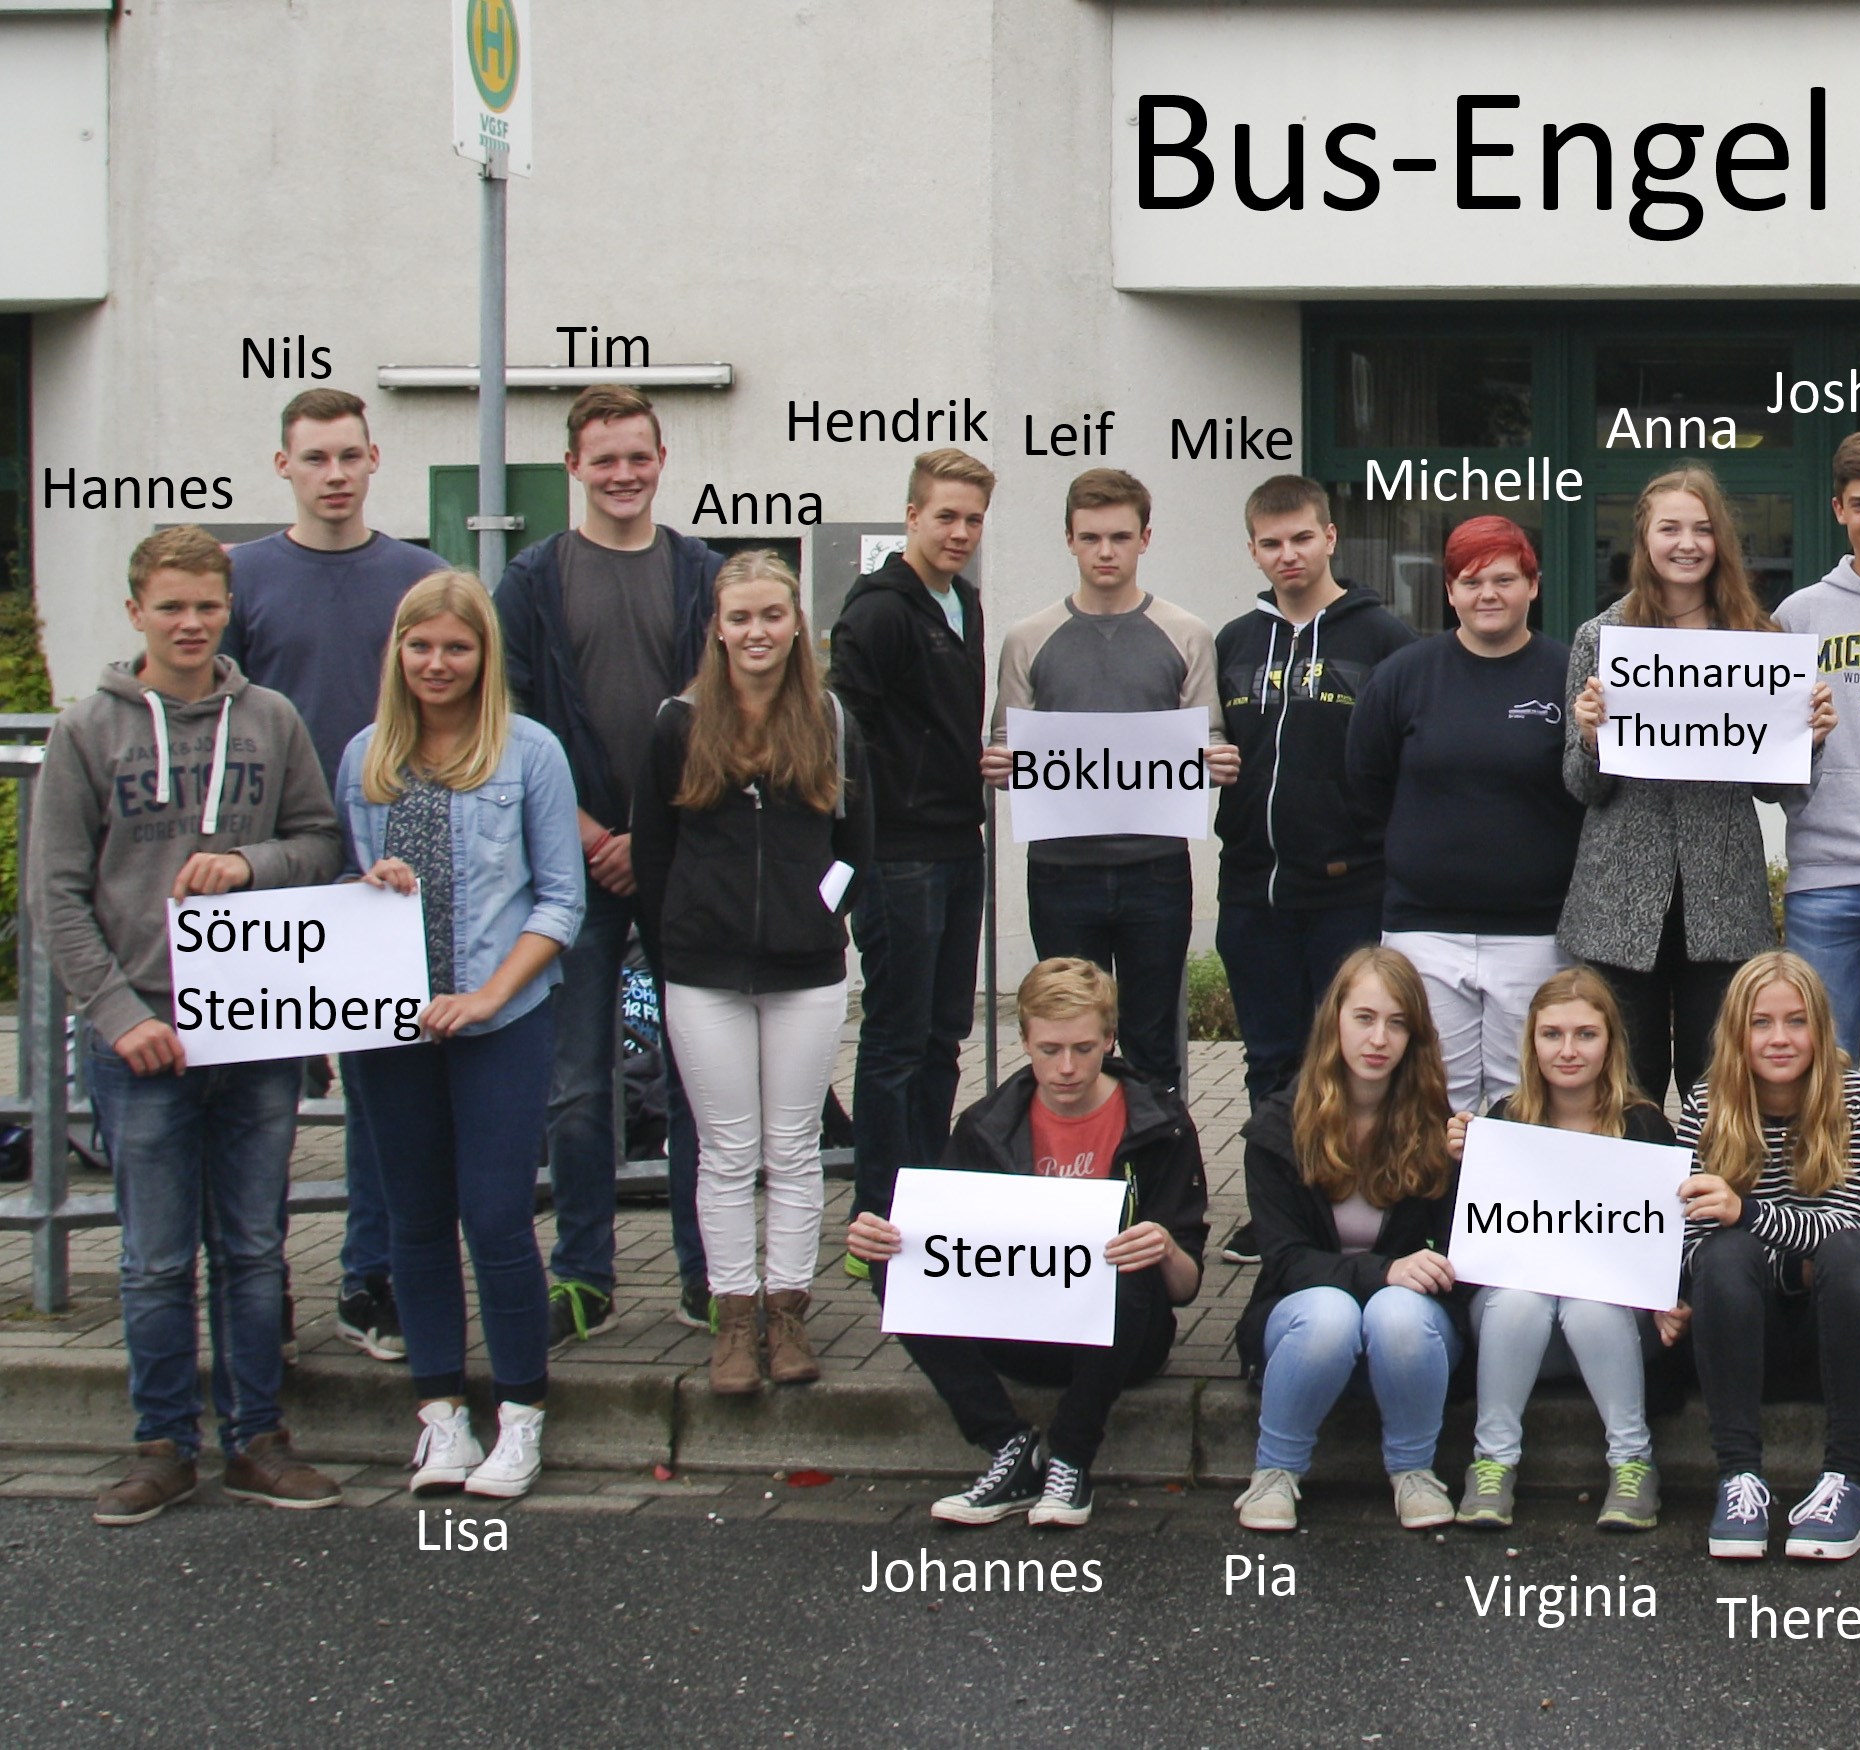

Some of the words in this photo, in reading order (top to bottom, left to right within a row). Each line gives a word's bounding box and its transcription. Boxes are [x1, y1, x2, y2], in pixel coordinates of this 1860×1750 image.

[480, 113, 509, 139] VGSF
[124, 738, 178, 763] JAK
[194, 735, 257, 754] JOES
[1037, 1151, 1095, 1177] Pull
